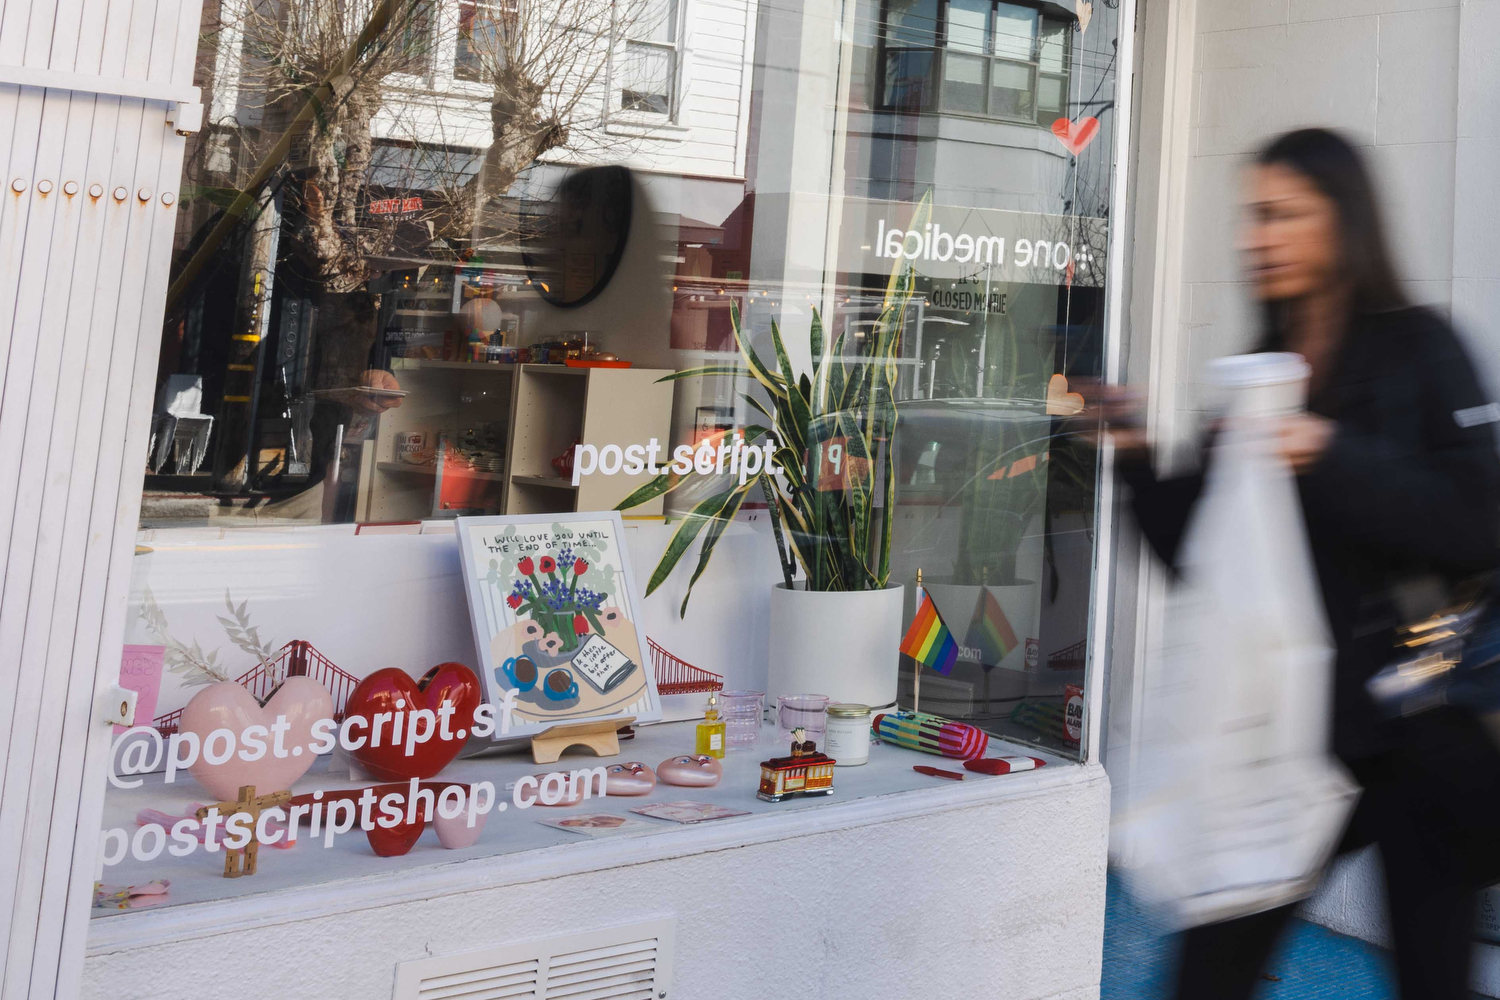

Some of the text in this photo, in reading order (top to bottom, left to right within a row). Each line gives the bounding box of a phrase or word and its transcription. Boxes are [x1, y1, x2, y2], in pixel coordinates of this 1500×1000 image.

[932, 290, 973, 311] CLOSED
[571, 433, 785, 487] post.script.
[488, 544, 510, 554] THE
[518, 543, 540, 552] END
[545, 541, 558, 550] OF
[494, 535, 519, 544] WILL
[524, 534, 549, 543] LOVE
[578, 531, 609, 540] UNTIL
[581, 644, 598, 659] then
[588, 649, 617, 675] bit after
[590, 644, 608, 663] little
[107, 687, 520, 789] @post.script.sf
[95, 761, 609, 880] postscriptshop.com
